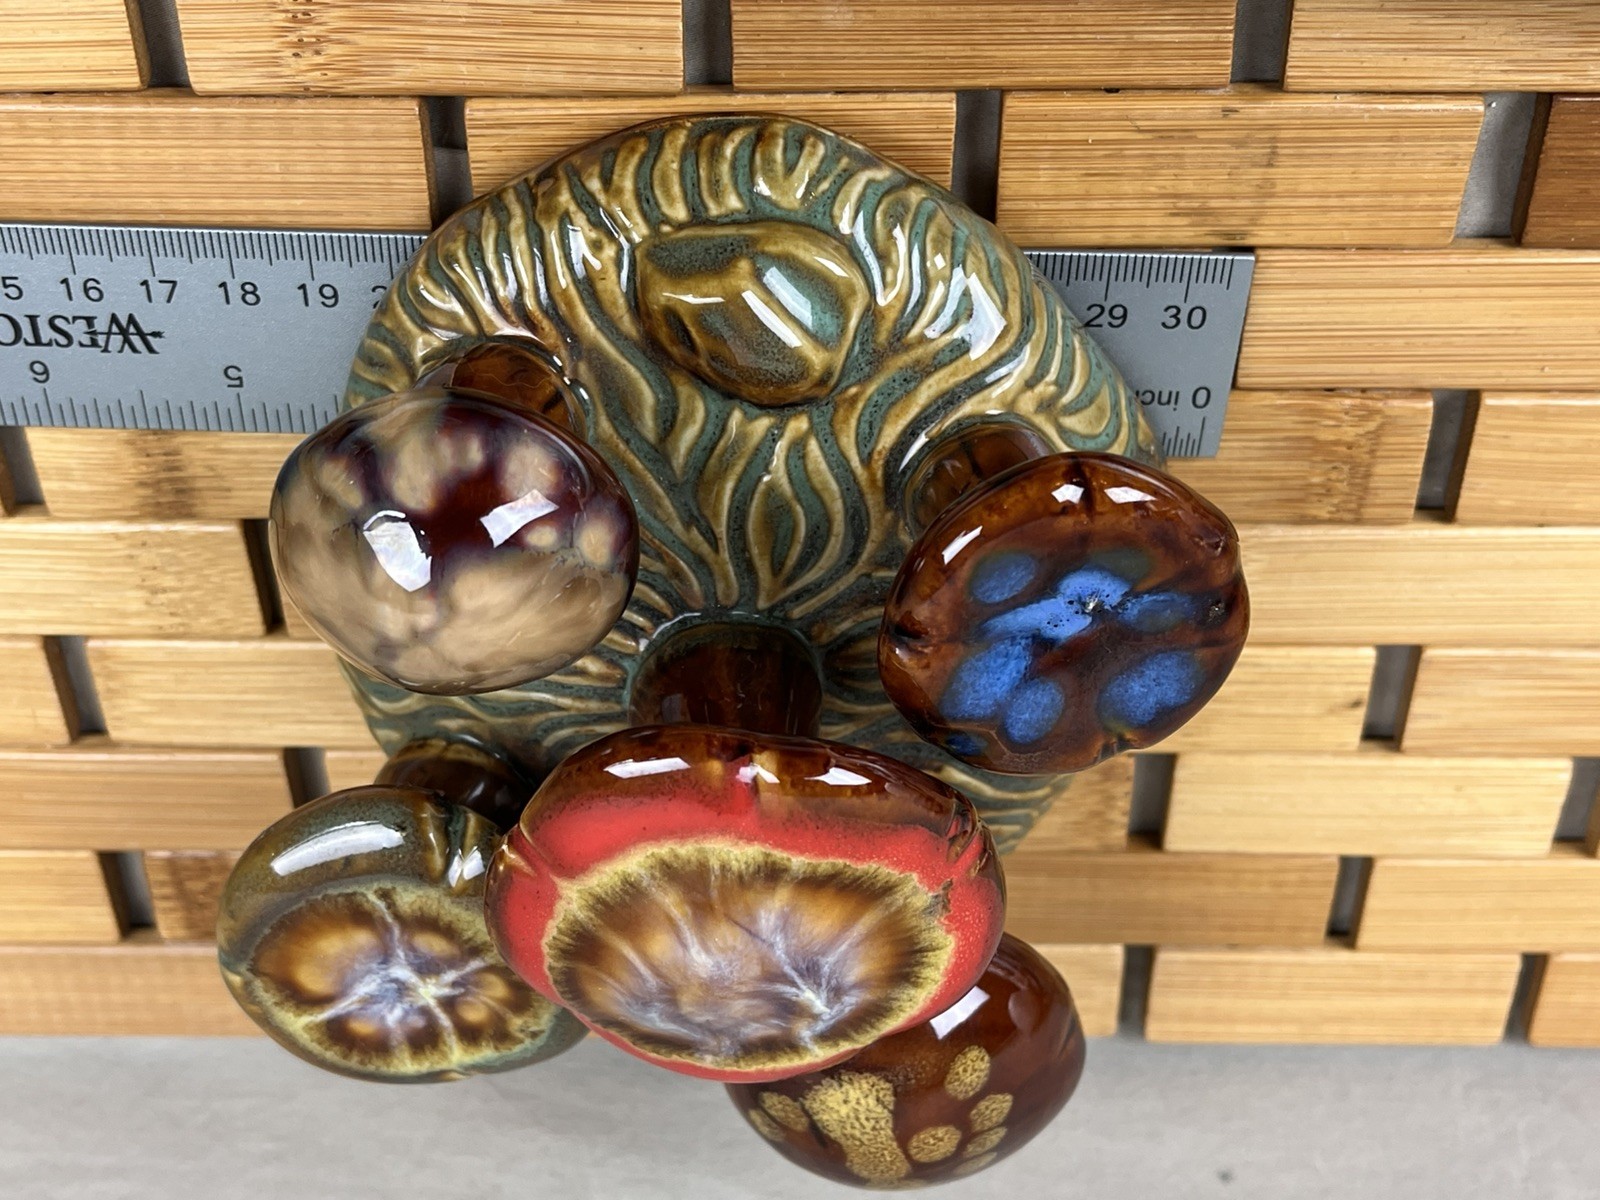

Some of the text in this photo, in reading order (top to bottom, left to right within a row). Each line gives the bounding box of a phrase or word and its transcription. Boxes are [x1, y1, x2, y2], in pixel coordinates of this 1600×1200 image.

[0, 276, 1207, 330] 5 16 17 18 19 29 30
[222, 365, 244, 388] 5
[1135, 386, 1212, 412] 0 inc
